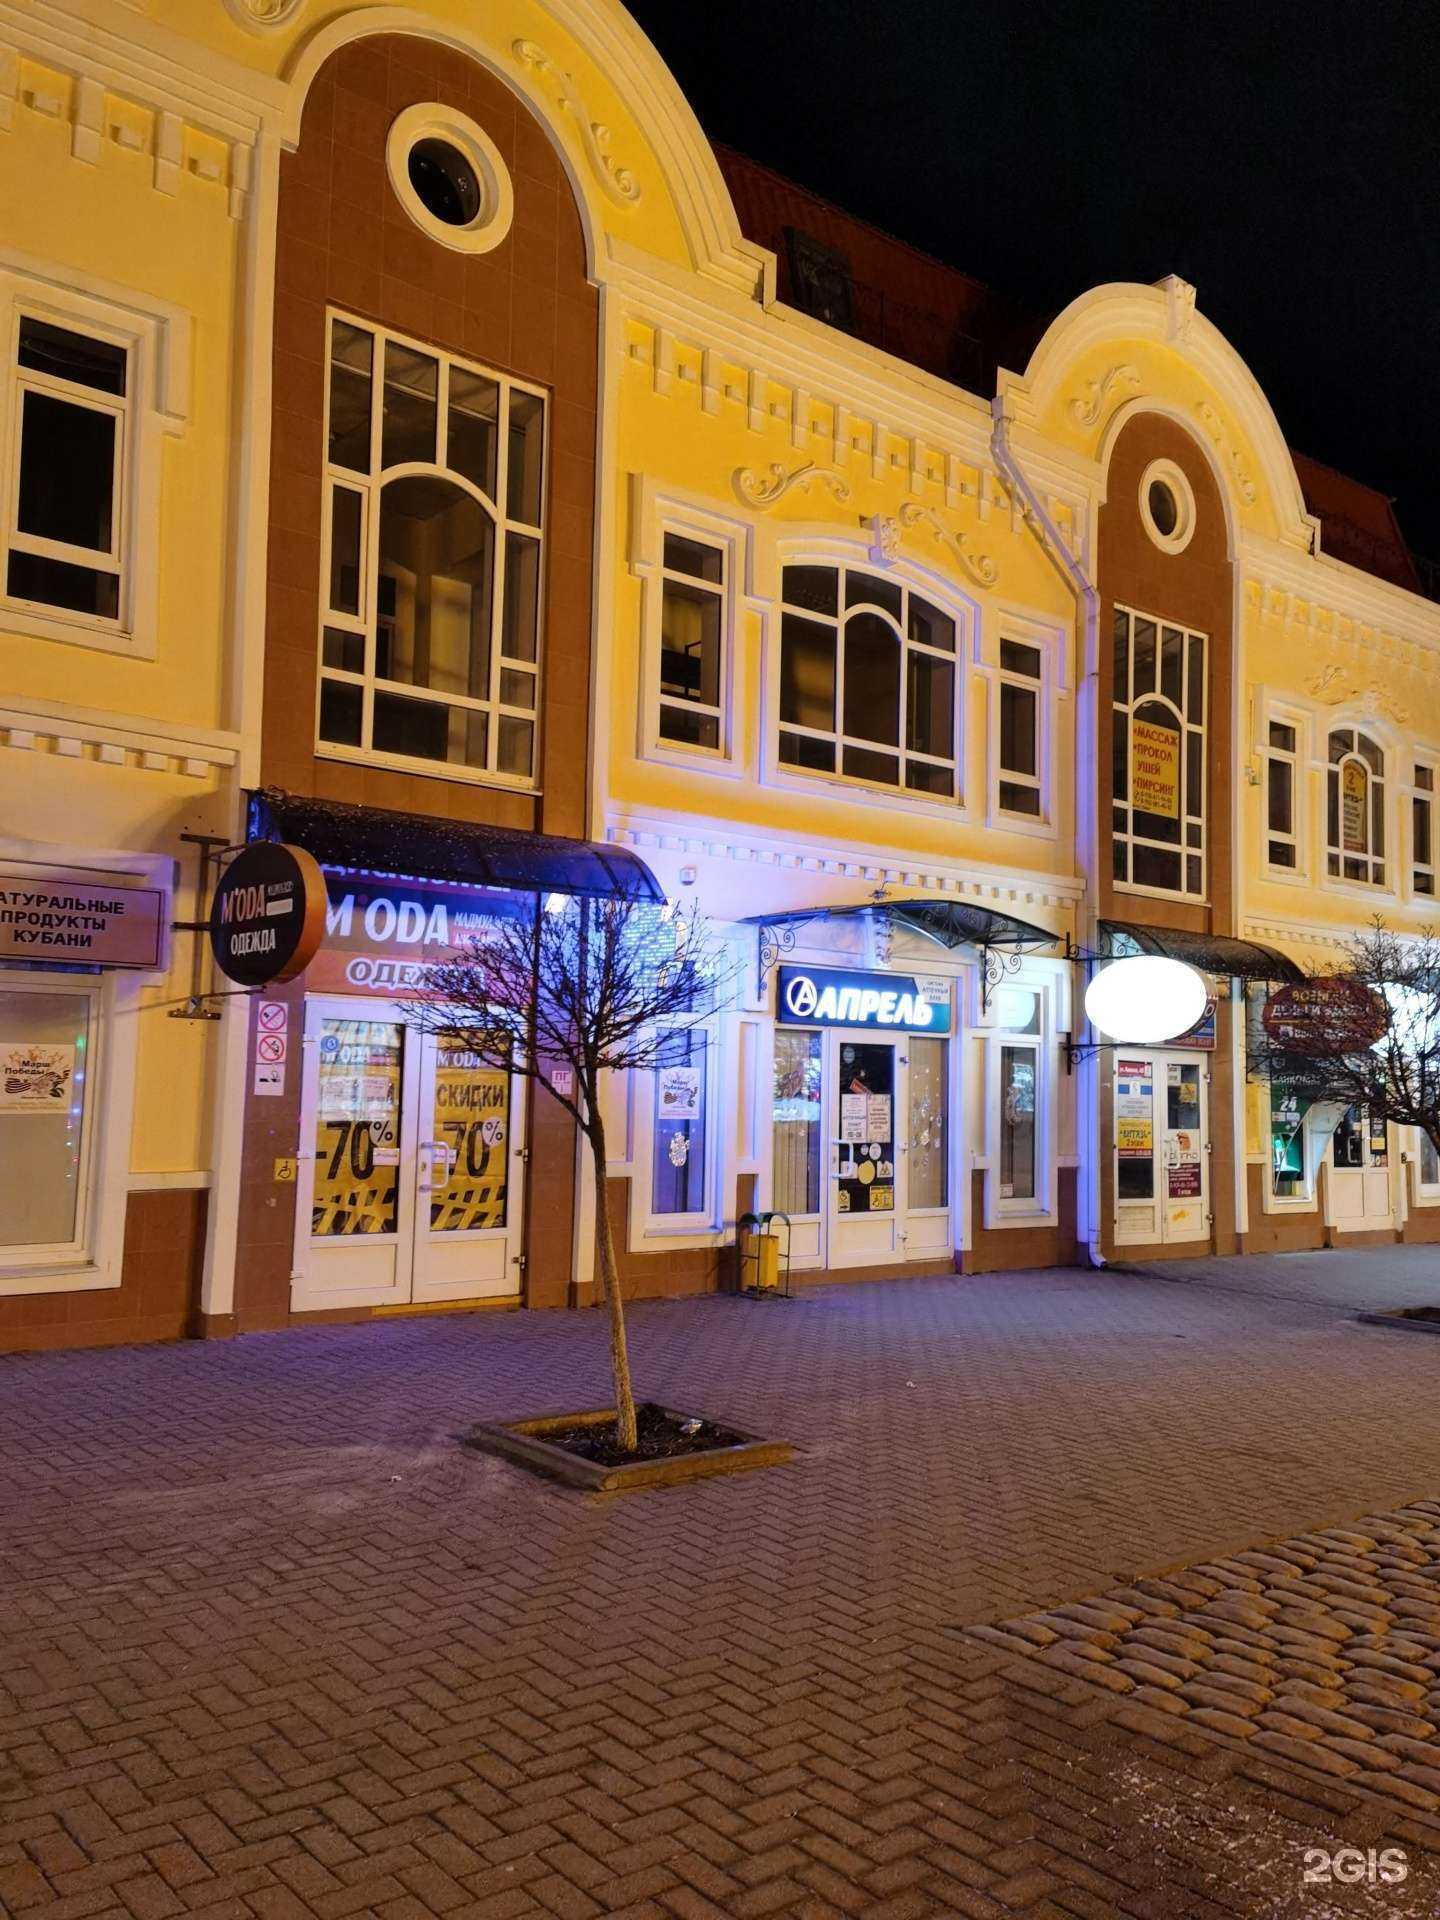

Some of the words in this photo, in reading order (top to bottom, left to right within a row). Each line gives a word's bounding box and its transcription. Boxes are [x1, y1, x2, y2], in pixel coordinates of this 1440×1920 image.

[1136, 726, 1177, 746] МАССАЖ
[1137, 743, 1173, 763] ПРОКОЛ
[1136, 778, 1175, 797] ПИРСИНГ
[1, 910, 106, 931] ПРОДУКТЫ
[14, 929, 92, 948] КУБАНИ
[231, 929, 276, 957] ОДЕЖДА
[814, 986, 933, 1026] АПРЕЛЬ
[5, 1067, 45, 1075] Победы
[22, 1060, 51, 1069] Марш
[437, 1084, 503, 1112] СКИДКИ
[1280, 1096, 1297, 1111] 24
